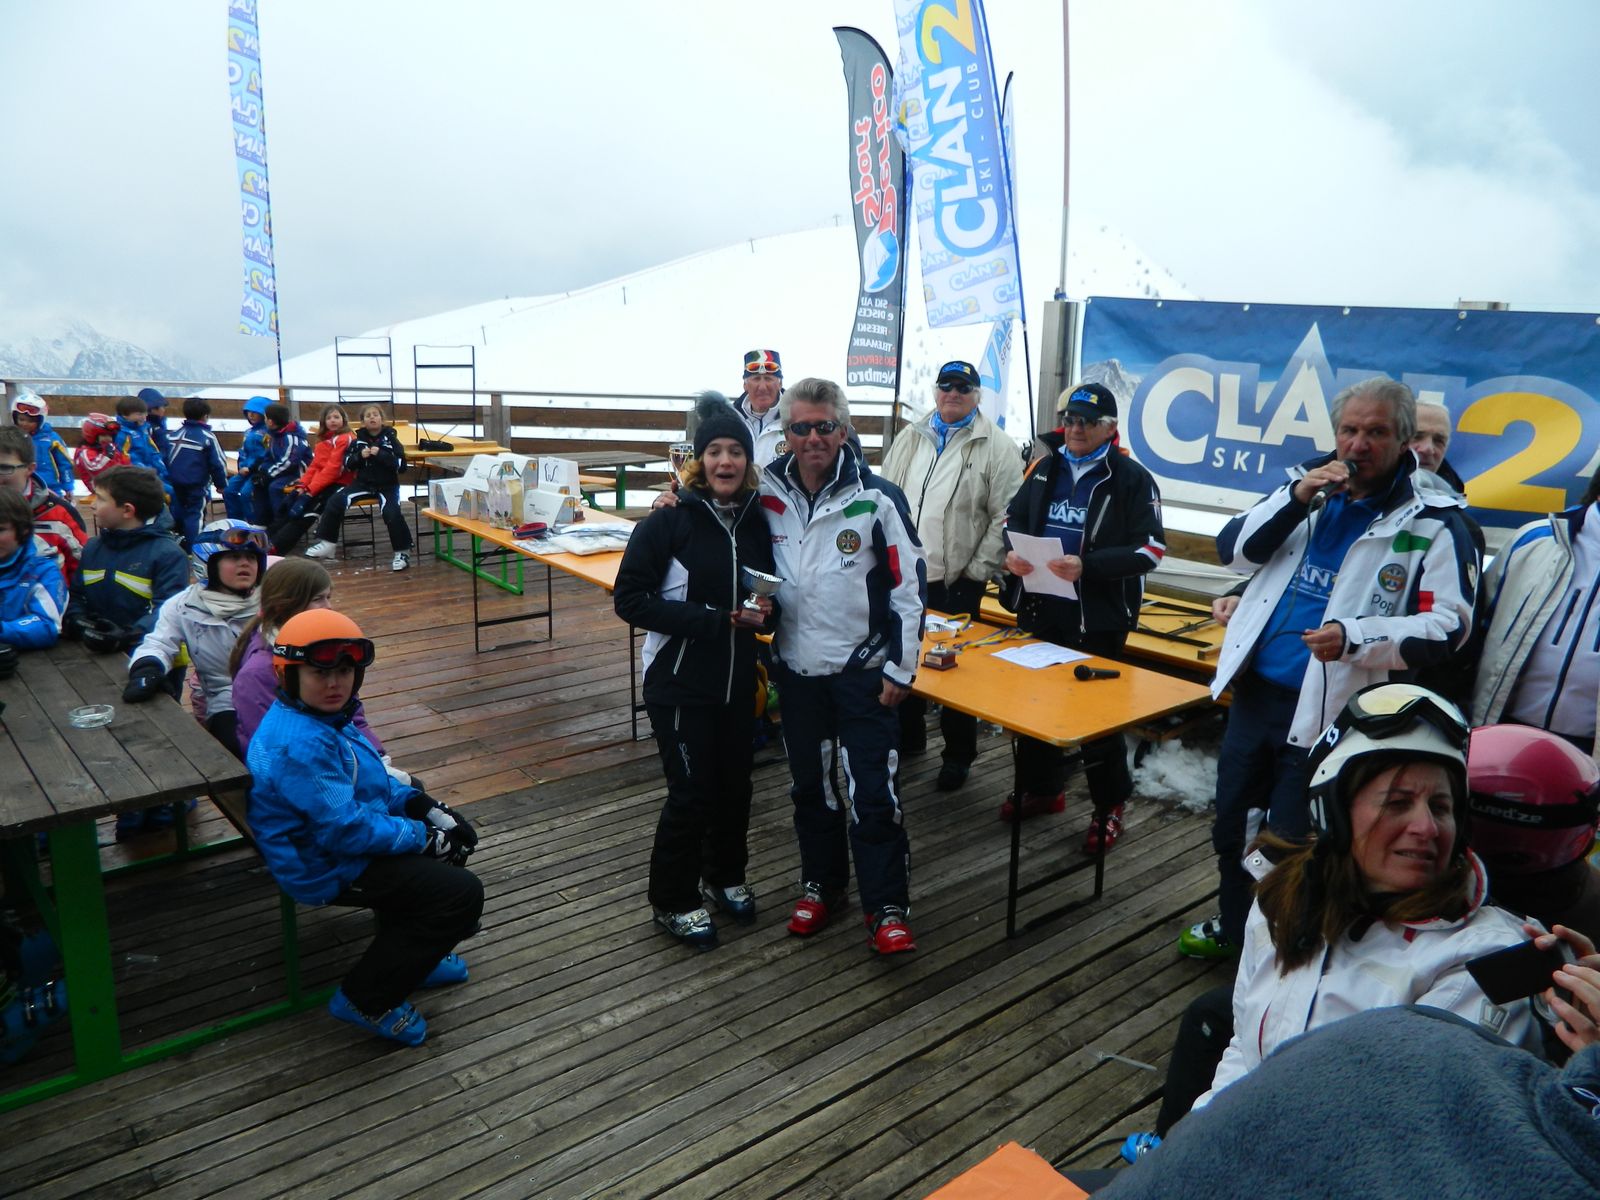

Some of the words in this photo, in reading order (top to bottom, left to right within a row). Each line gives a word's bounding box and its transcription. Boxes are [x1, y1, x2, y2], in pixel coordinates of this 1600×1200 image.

[967, 63, 984, 119] CLUB
[978, 158, 993, 192] SKI
[1212, 447, 1265, 475] SKI
[840, 557, 856, 568] Ivo
